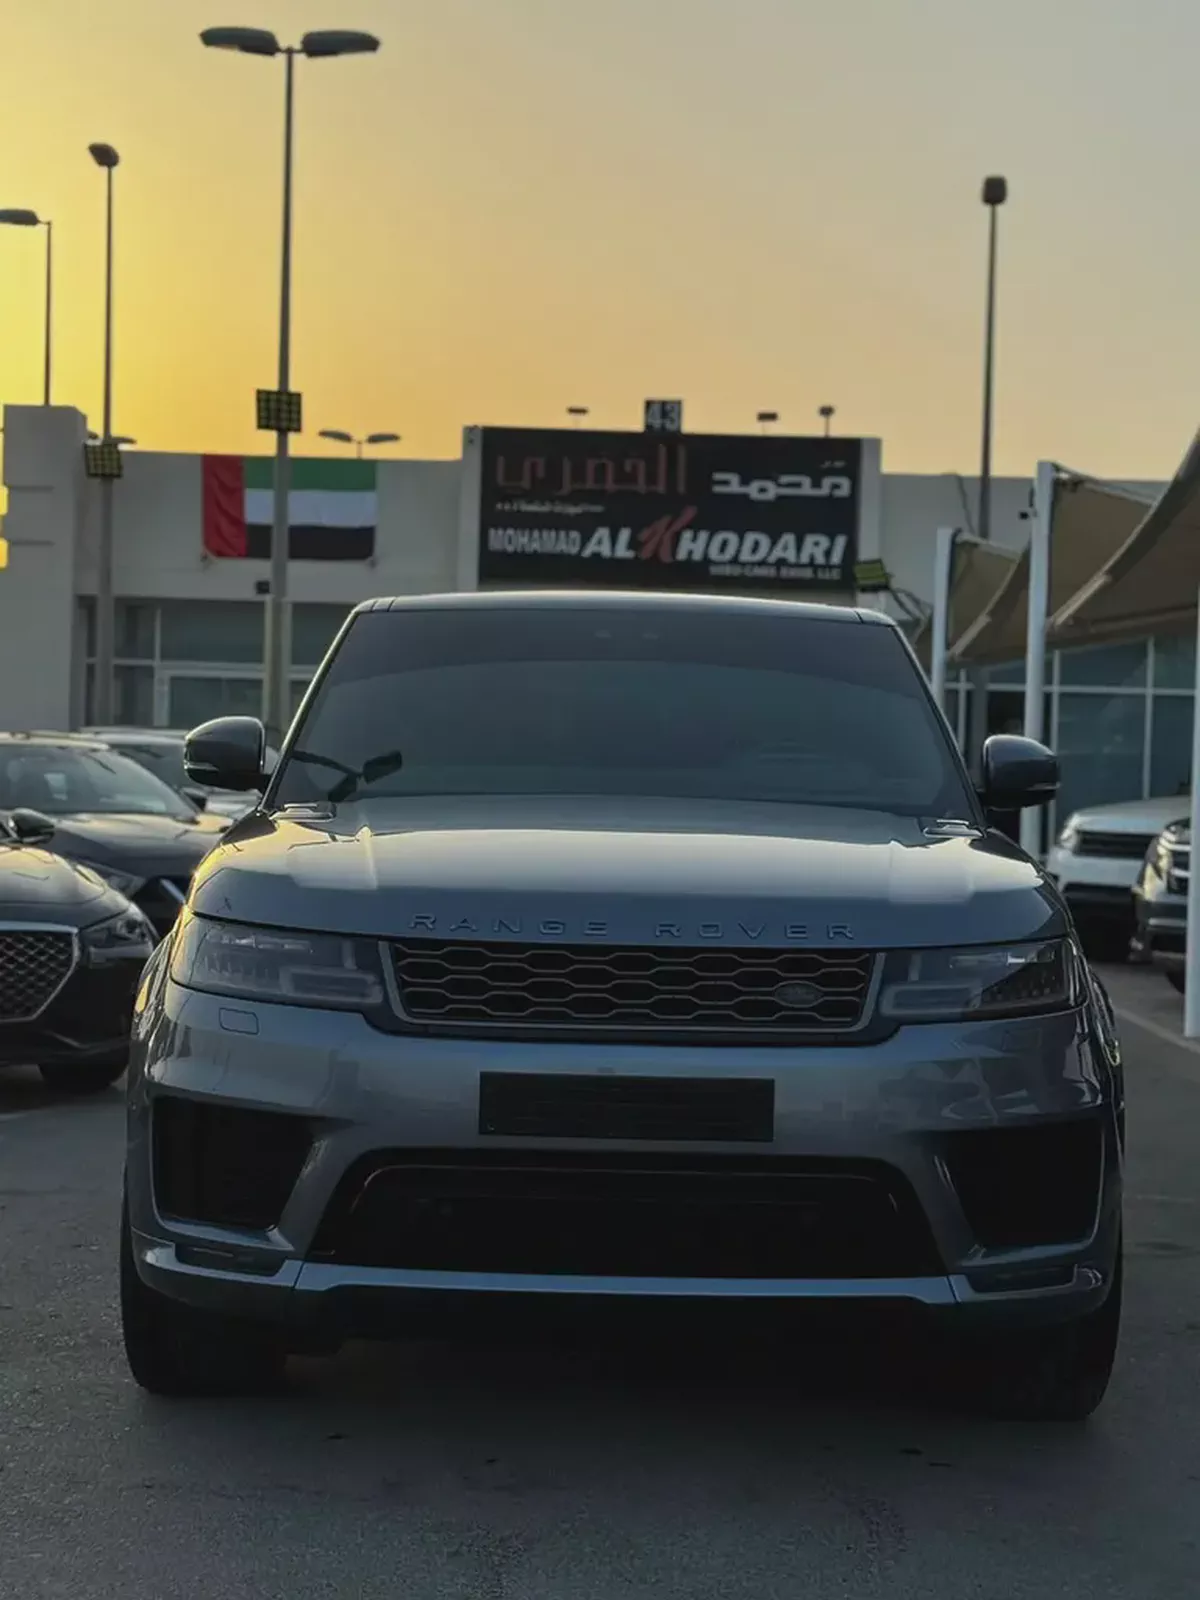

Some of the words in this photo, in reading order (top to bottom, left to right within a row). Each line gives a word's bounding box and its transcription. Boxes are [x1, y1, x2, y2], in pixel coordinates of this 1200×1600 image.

[645, 401, 681, 430] 43
[711, 472, 851, 501] محمد
[488, 527, 581, 554] MOHAMAD
[582, 527, 637, 560] AL
[408, 913, 609, 936] RANGE
[653, 921, 856, 941] ROVER
